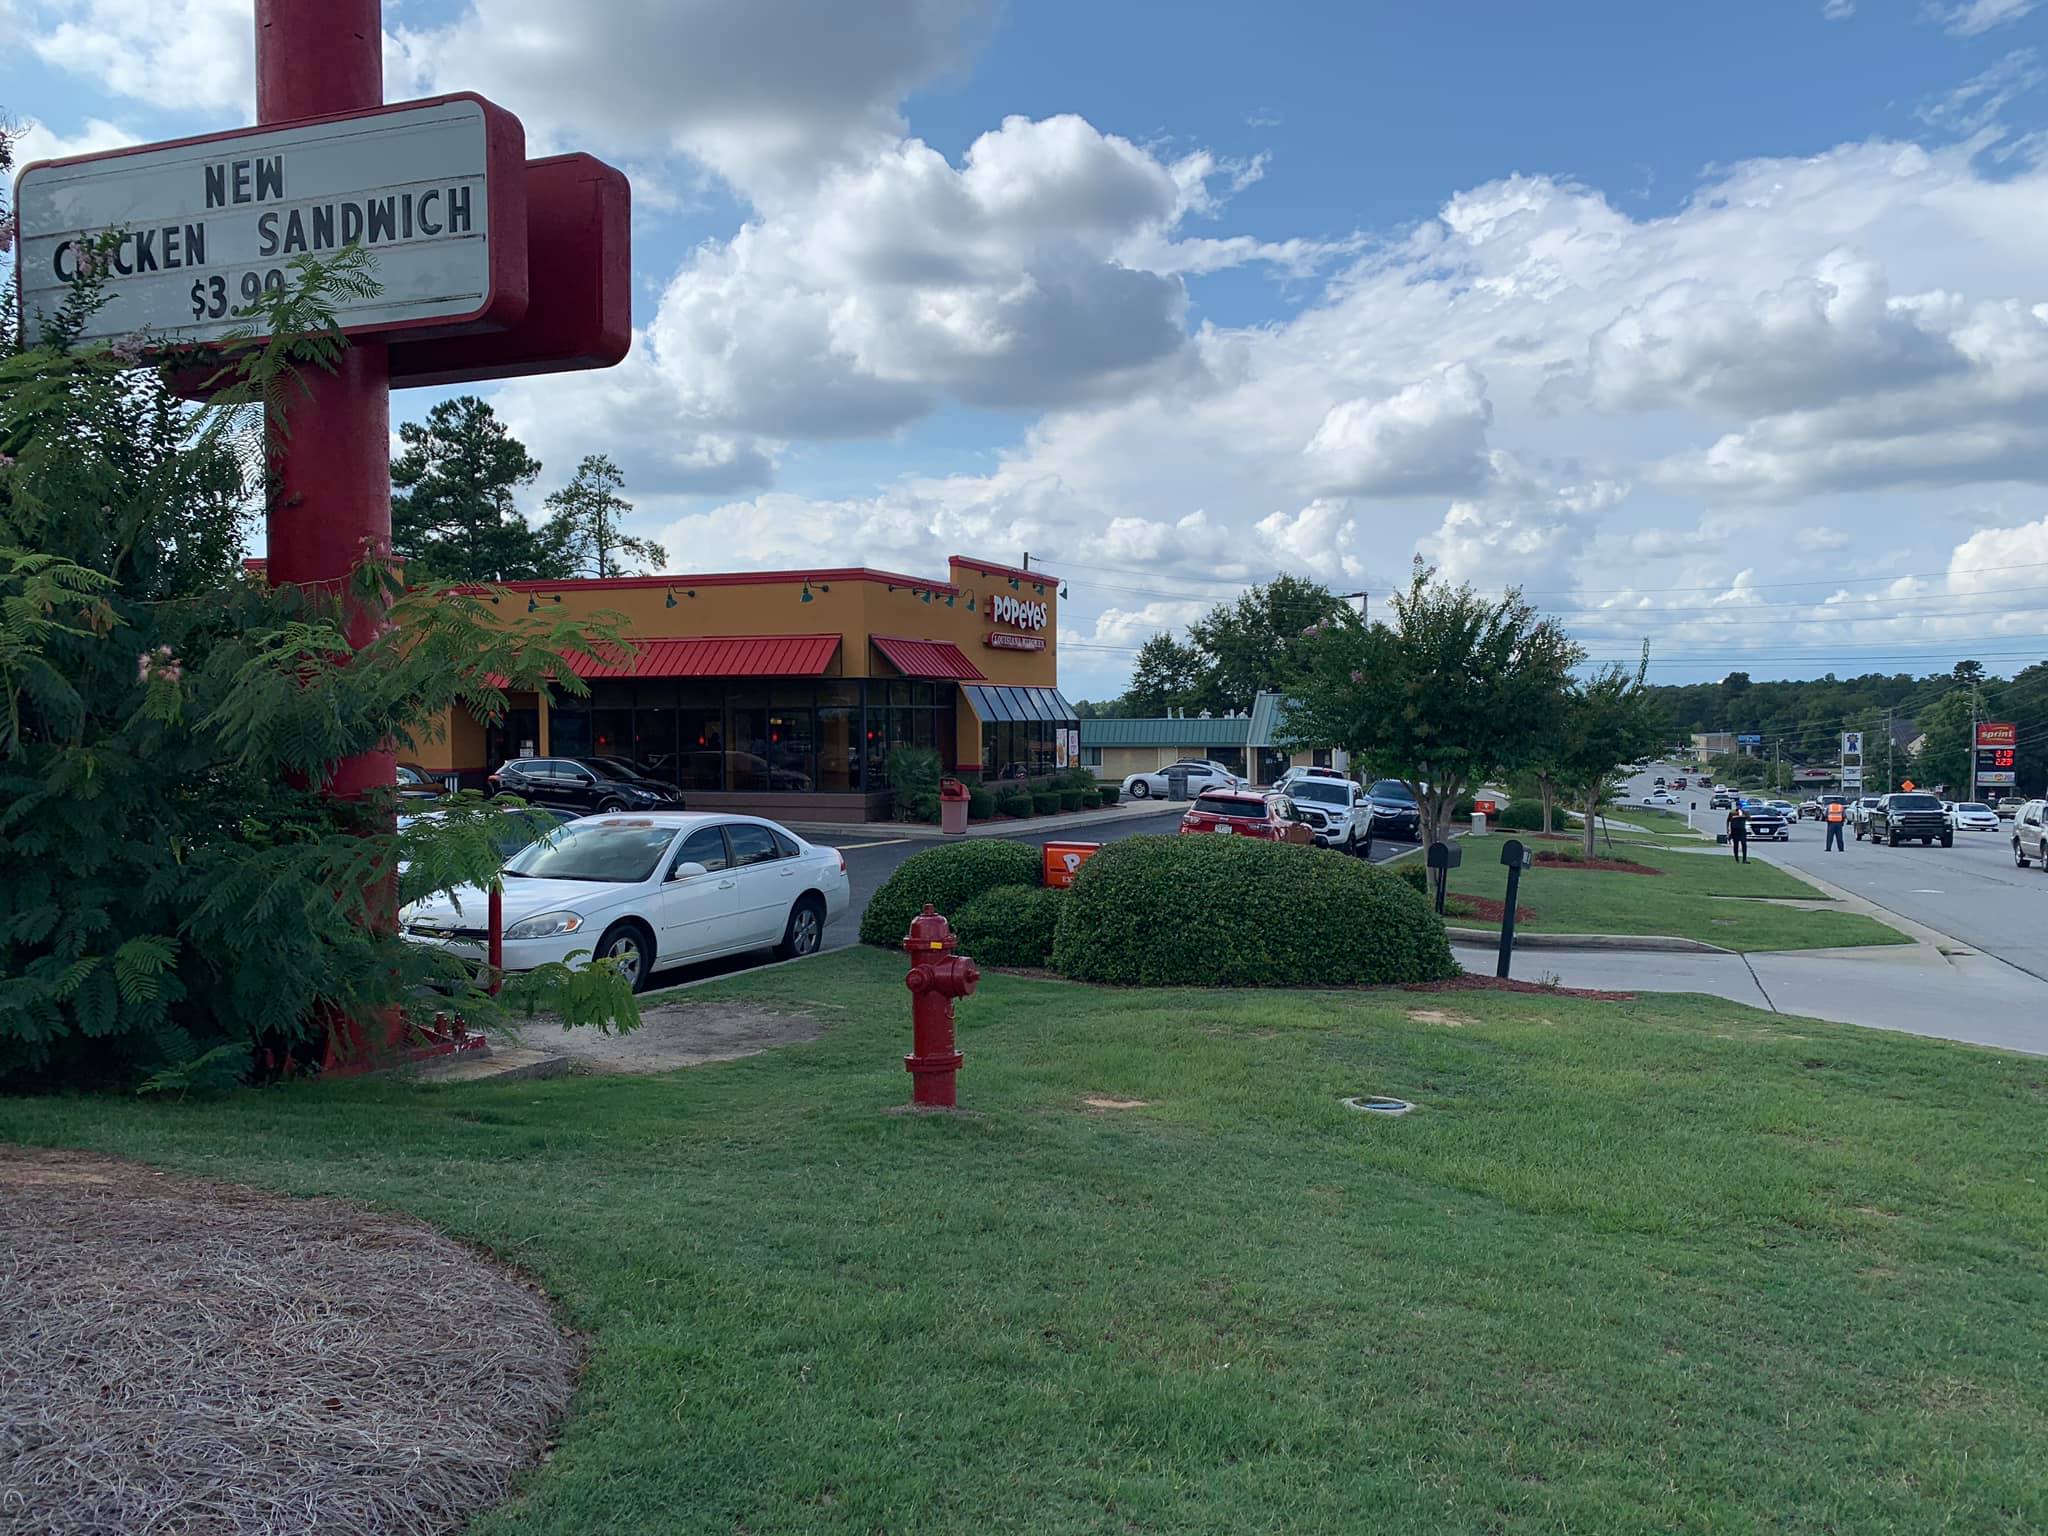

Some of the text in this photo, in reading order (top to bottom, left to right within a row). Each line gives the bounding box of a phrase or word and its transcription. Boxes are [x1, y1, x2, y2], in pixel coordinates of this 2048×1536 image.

[206, 155, 283, 208] NEW
[54, 186, 471, 282] CCKEN SANDWICH
[191, 268, 285, 320] $3.99
[1982, 730, 2013, 739] sprint
